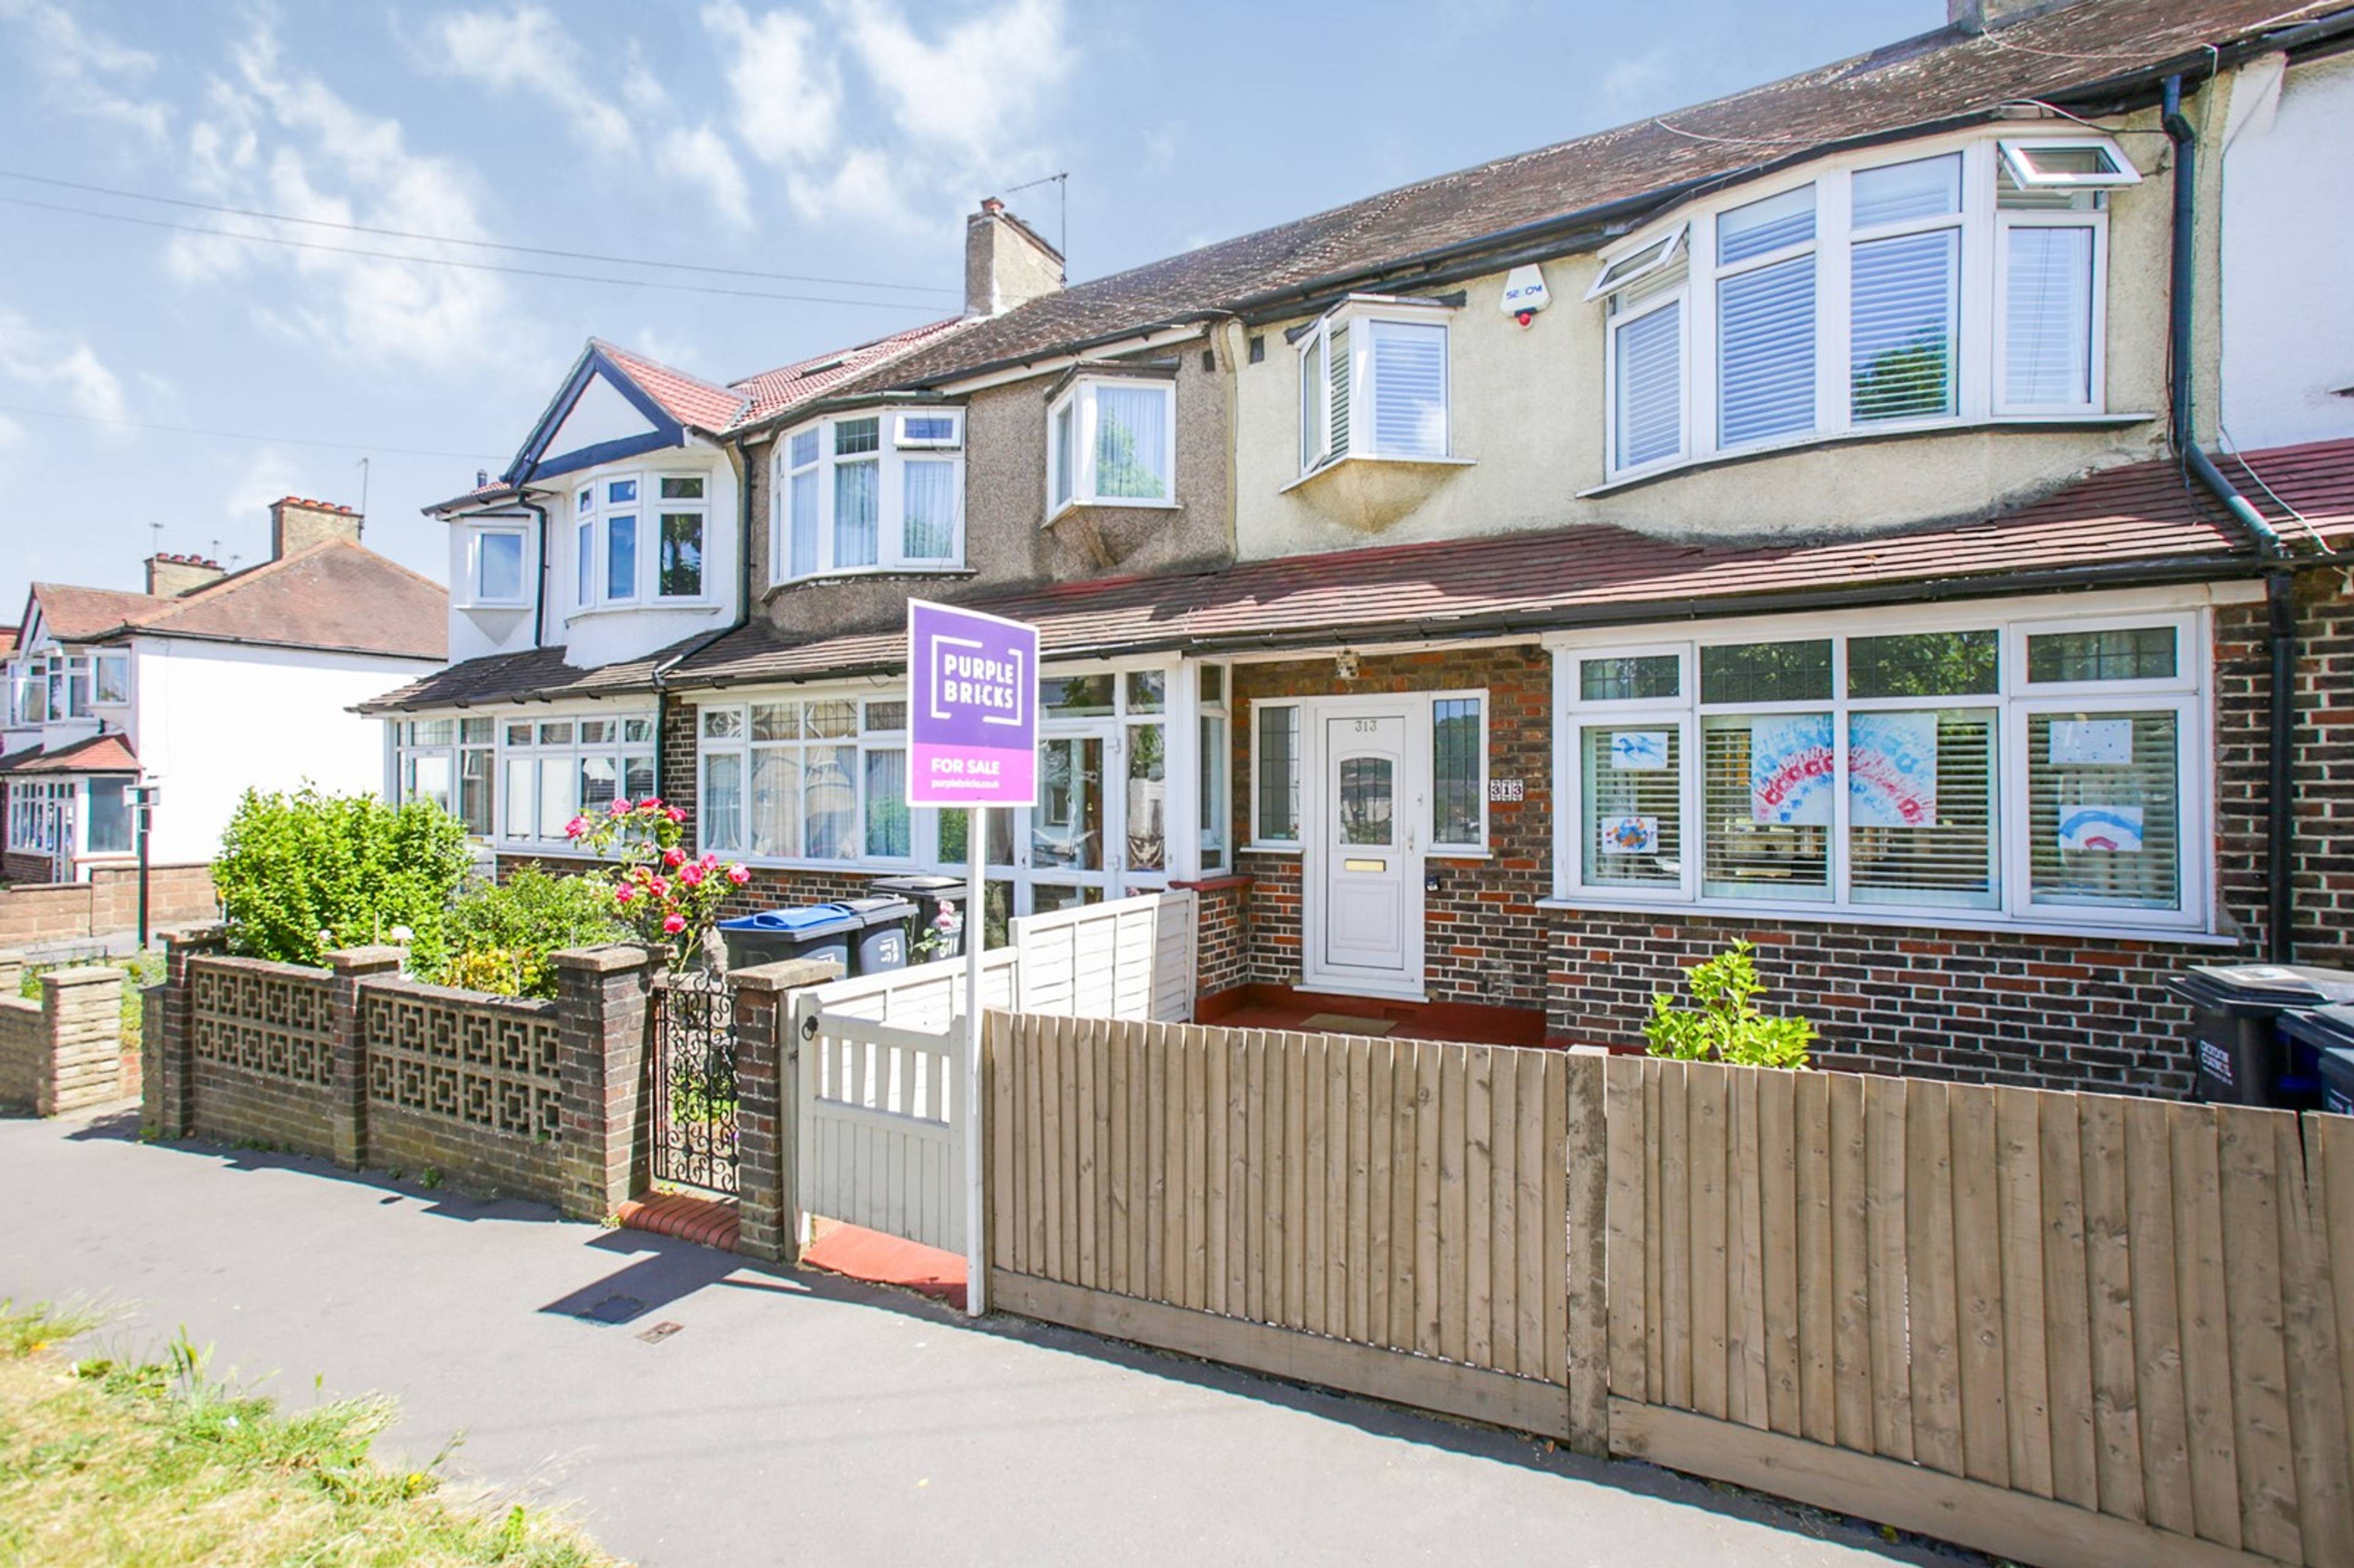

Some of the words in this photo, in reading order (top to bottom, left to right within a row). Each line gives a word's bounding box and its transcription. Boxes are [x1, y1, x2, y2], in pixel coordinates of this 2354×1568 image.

[944, 653, 1013, 685] PURPLE
[944, 679, 1013, 709] BRICKS
[1355, 720, 1377, 732] 313
[931, 757, 963, 774] FOR
[967, 758, 1000, 775] SALE
[1491, 785, 1522, 795] 313
